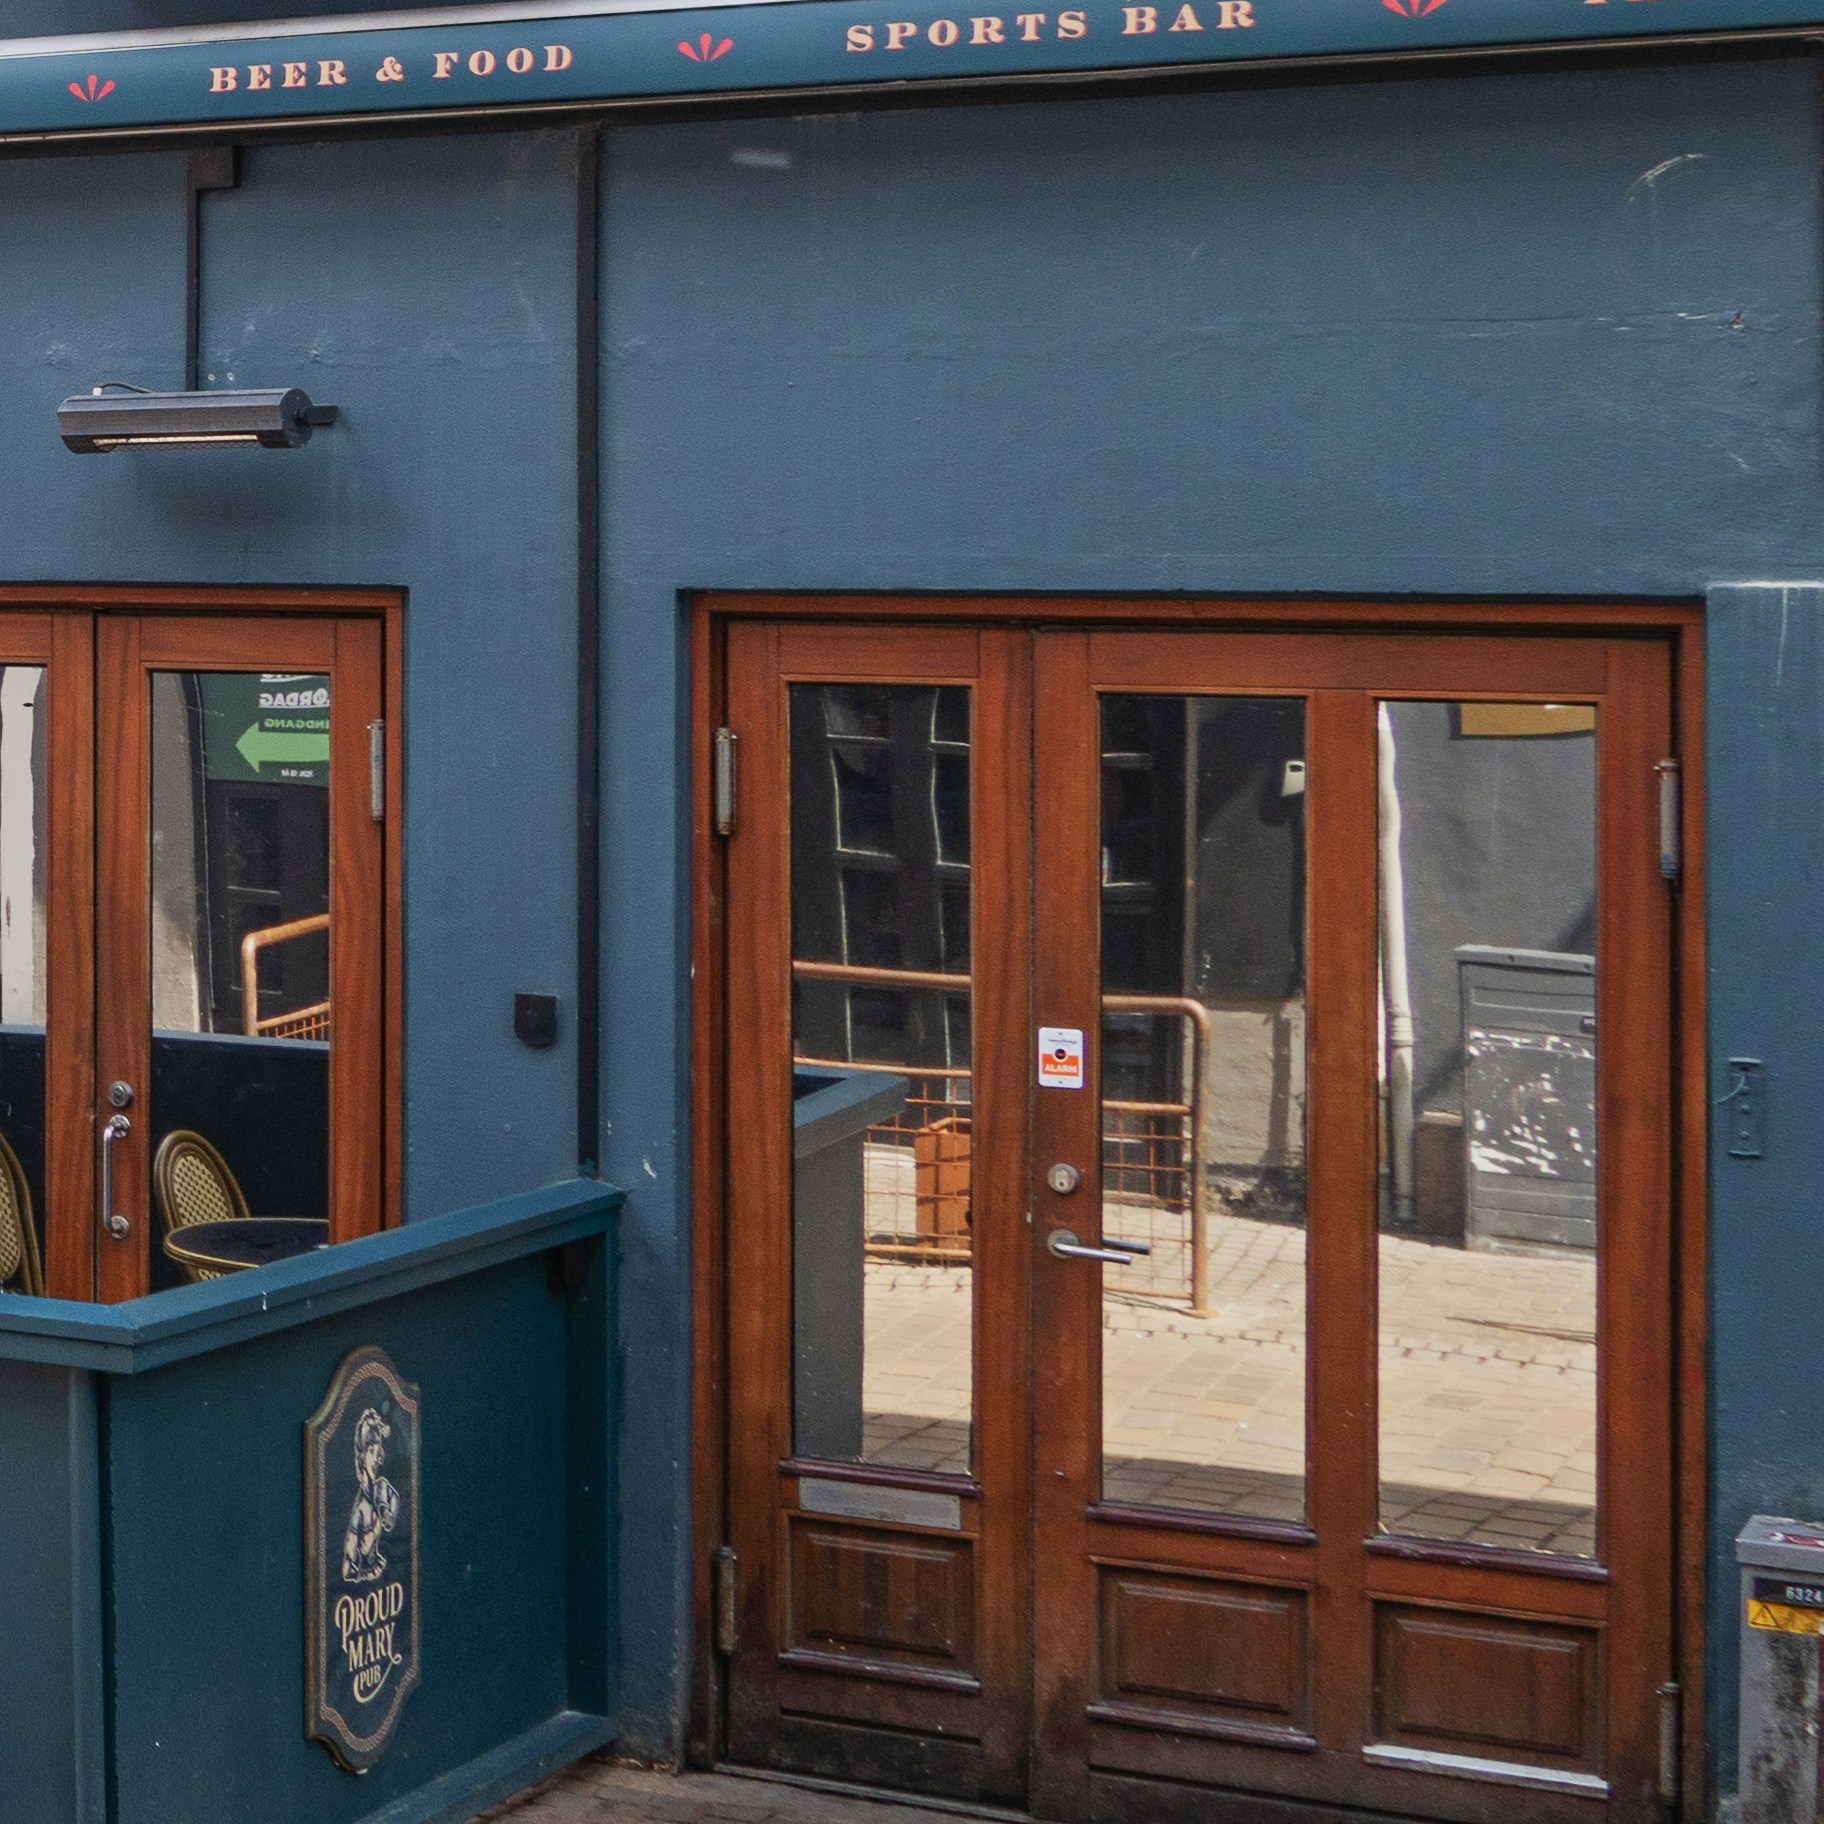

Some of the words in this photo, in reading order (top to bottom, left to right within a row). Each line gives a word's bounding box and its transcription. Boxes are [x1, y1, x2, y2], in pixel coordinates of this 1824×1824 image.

[845, 10, 1087, 53] SPORTS
[1121, 0, 1256, 36] BAR
[209, 59, 348, 93] BEER
[375, 56, 404, 83] &
[432, 45, 575, 79] FOOD
[335, 1581, 404, 1654] PROUD
[348, 1621, 396, 1674] MARY
